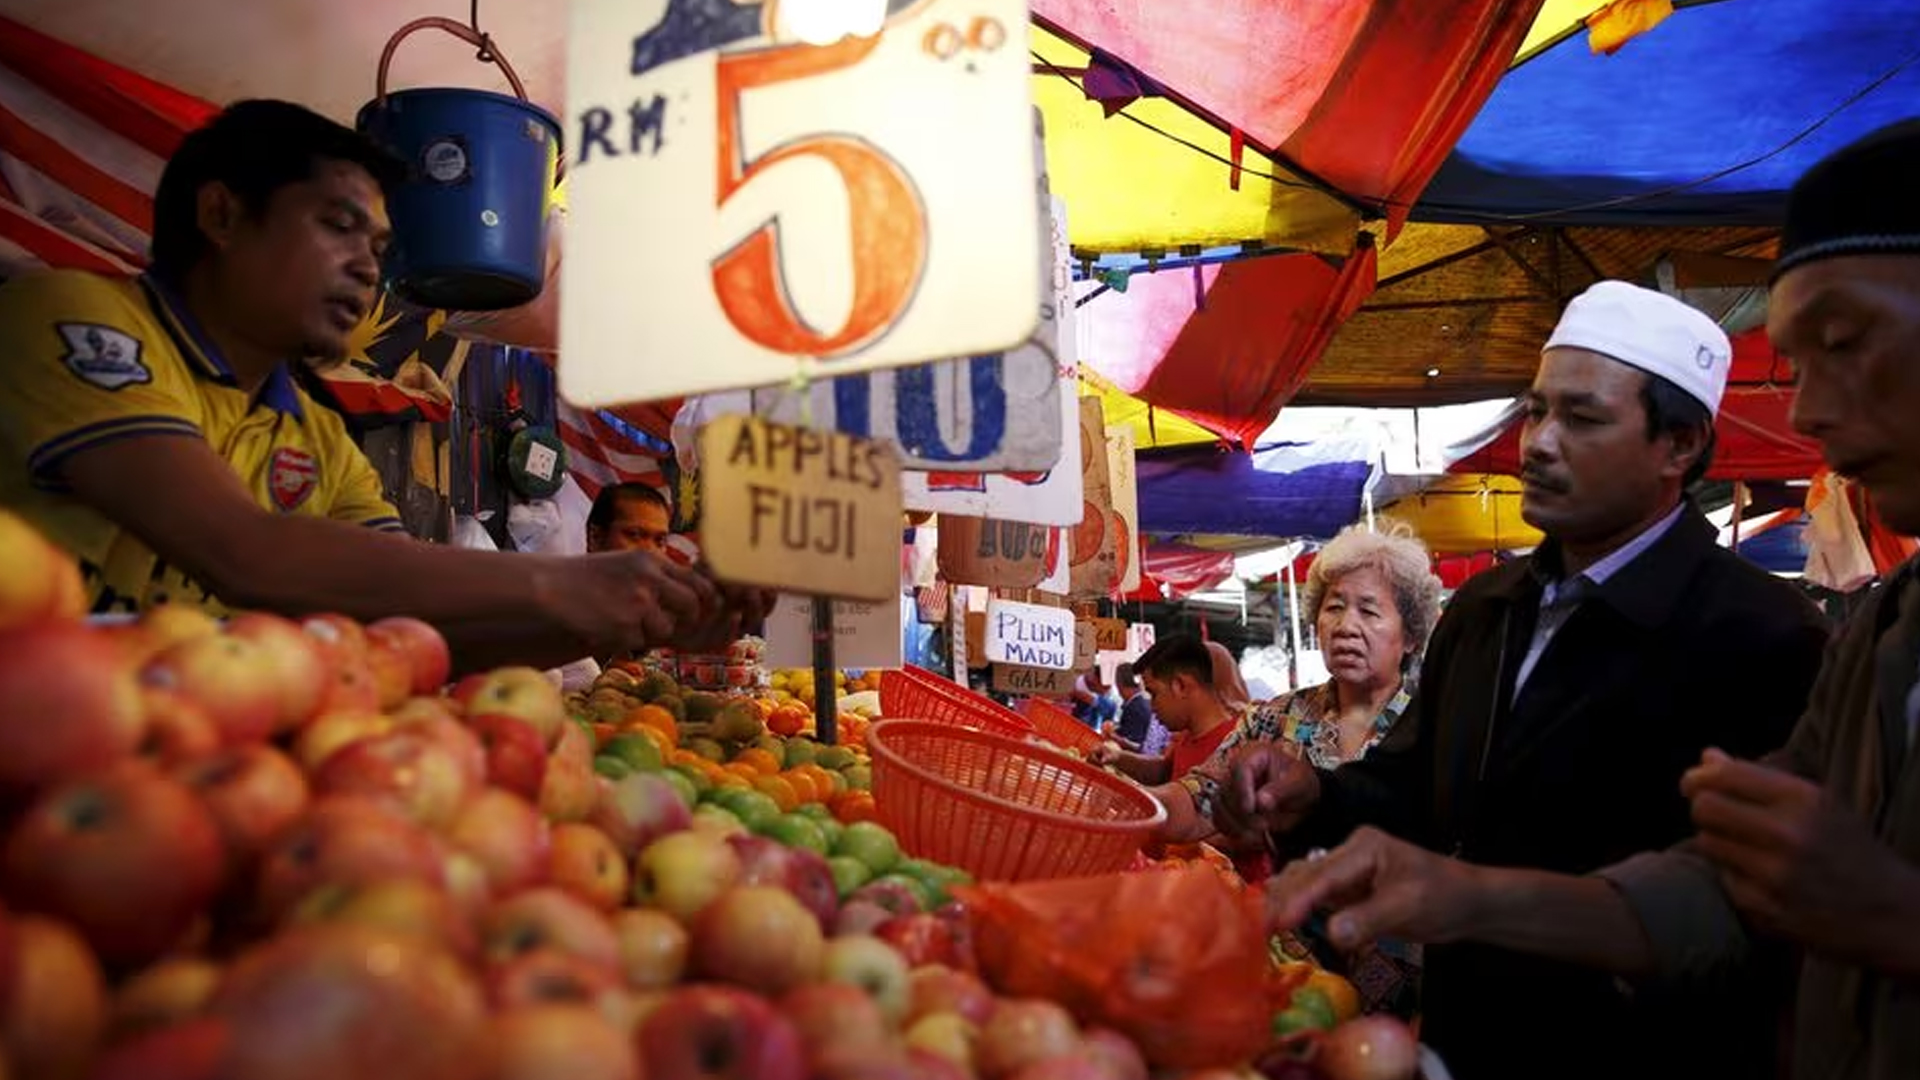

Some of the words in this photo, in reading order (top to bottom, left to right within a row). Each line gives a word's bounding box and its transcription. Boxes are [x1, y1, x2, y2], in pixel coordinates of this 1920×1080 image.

[711, 28, 929, 361] 5
[729, 420, 884, 490] APPLES
[748, 485, 857, 560] FUJI
[996, 610, 1065, 648] PLUM
[1004, 641, 1066, 668] MADU
[1008, 668, 1057, 692] GALA
